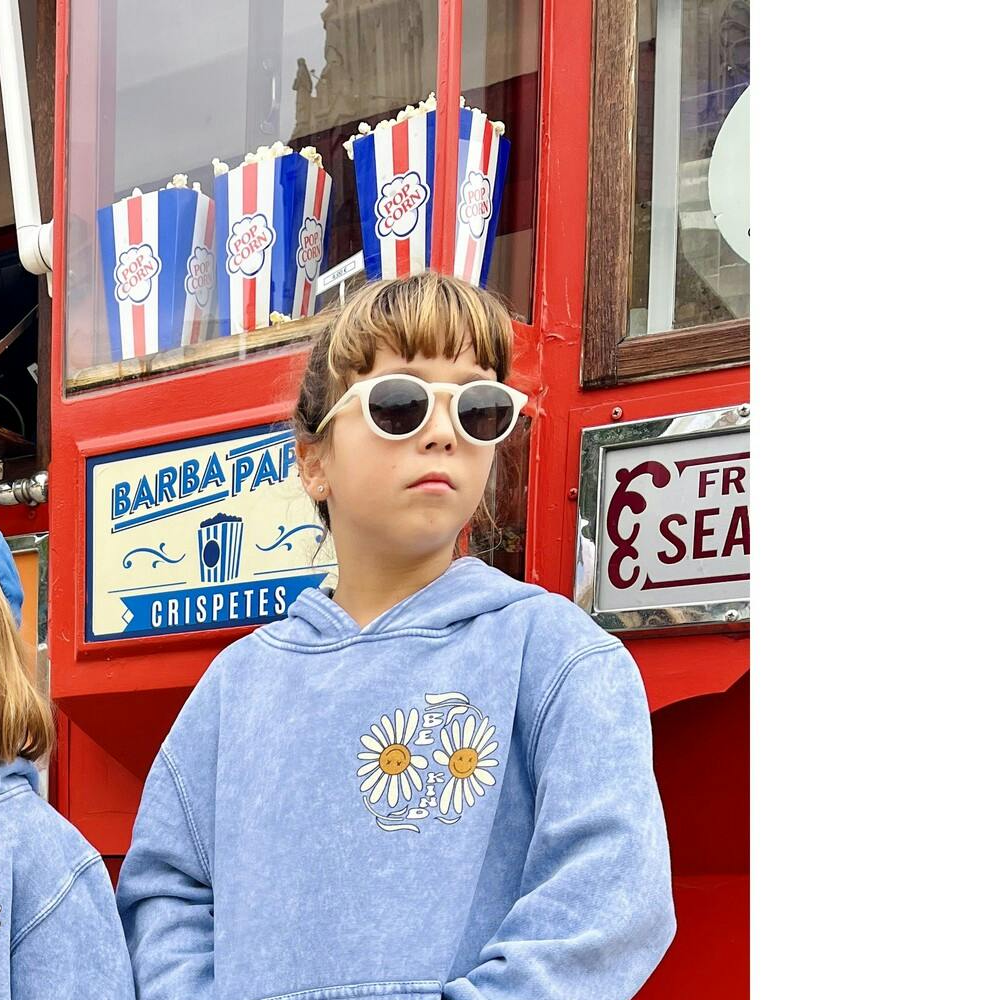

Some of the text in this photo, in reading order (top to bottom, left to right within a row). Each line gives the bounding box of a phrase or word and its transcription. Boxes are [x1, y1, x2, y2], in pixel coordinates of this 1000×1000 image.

[384, 183, 411, 215] POP
[384, 190, 422, 229] CORN
[465, 200, 489, 218] CORN
[468, 187, 486, 203] POP
[233, 224, 258, 252] POP
[233, 231, 267, 266] CORN
[302, 245, 320, 262] CORN
[304, 232, 319, 249] POP
[121, 255, 144, 280] POP
[121, 261, 154, 294] CORN
[194, 261, 210, 276] POP
[111, 441, 300, 520] BARBA PAP
[698, 466, 746, 499] FR
[657, 505, 750, 565] SEA
[151, 586, 287, 628] CRISPETES
[413, 711, 445, 746] BE
[405, 771, 445, 820] KIND
